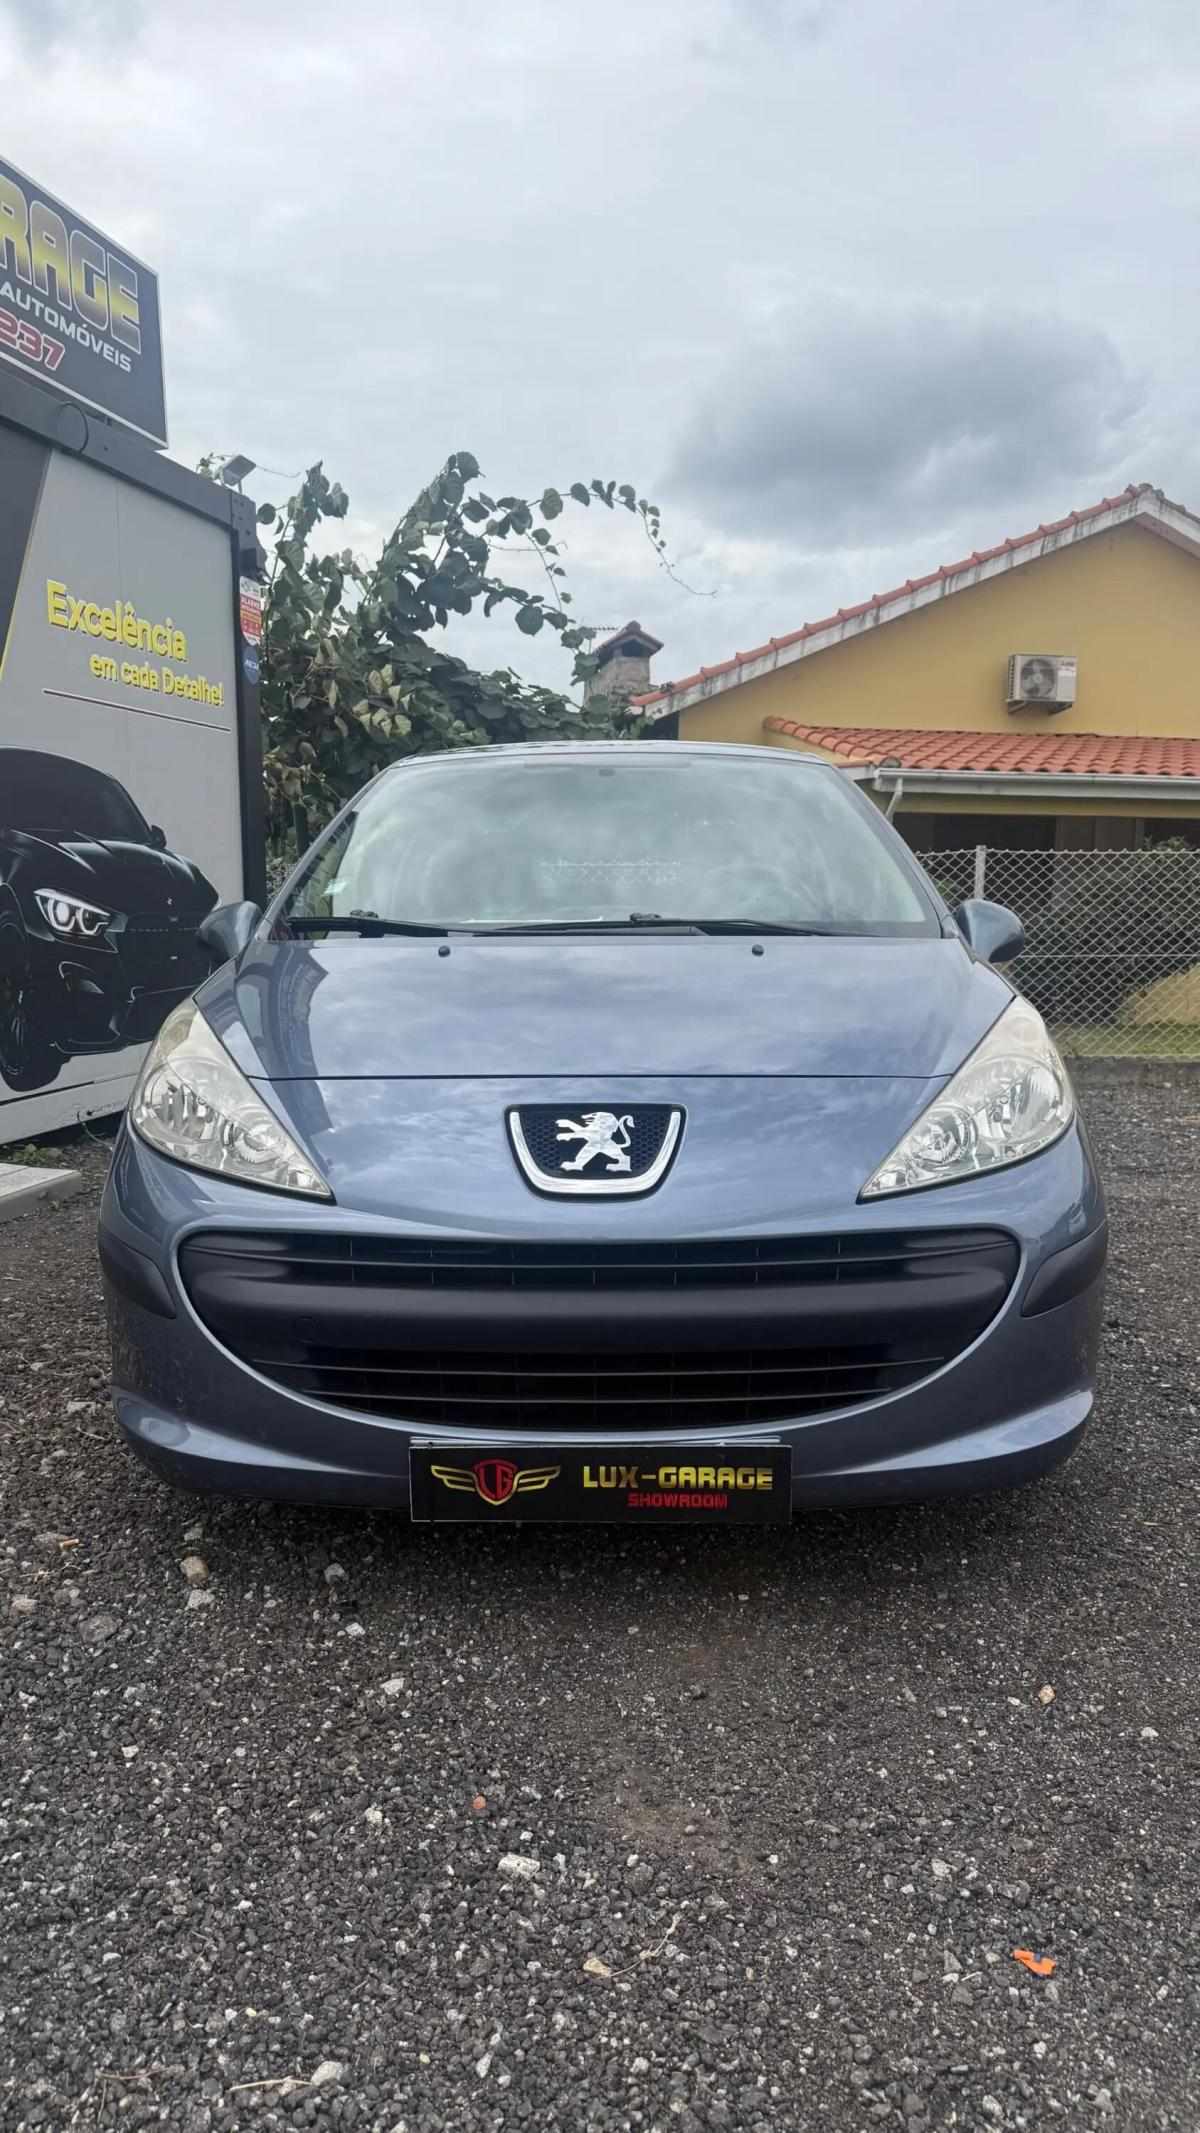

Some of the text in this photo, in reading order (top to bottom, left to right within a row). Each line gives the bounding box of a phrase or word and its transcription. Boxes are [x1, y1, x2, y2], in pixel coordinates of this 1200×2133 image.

[0, 280, 132, 373] AUTOMÓVEIS
[47, 579, 188, 663] Excelência
[89, 653, 225, 708] em cada Detalhe!
[583, 1465, 774, 1490] LUX-GARAGE
[628, 1492, 728, 1509] SHOWROOM
